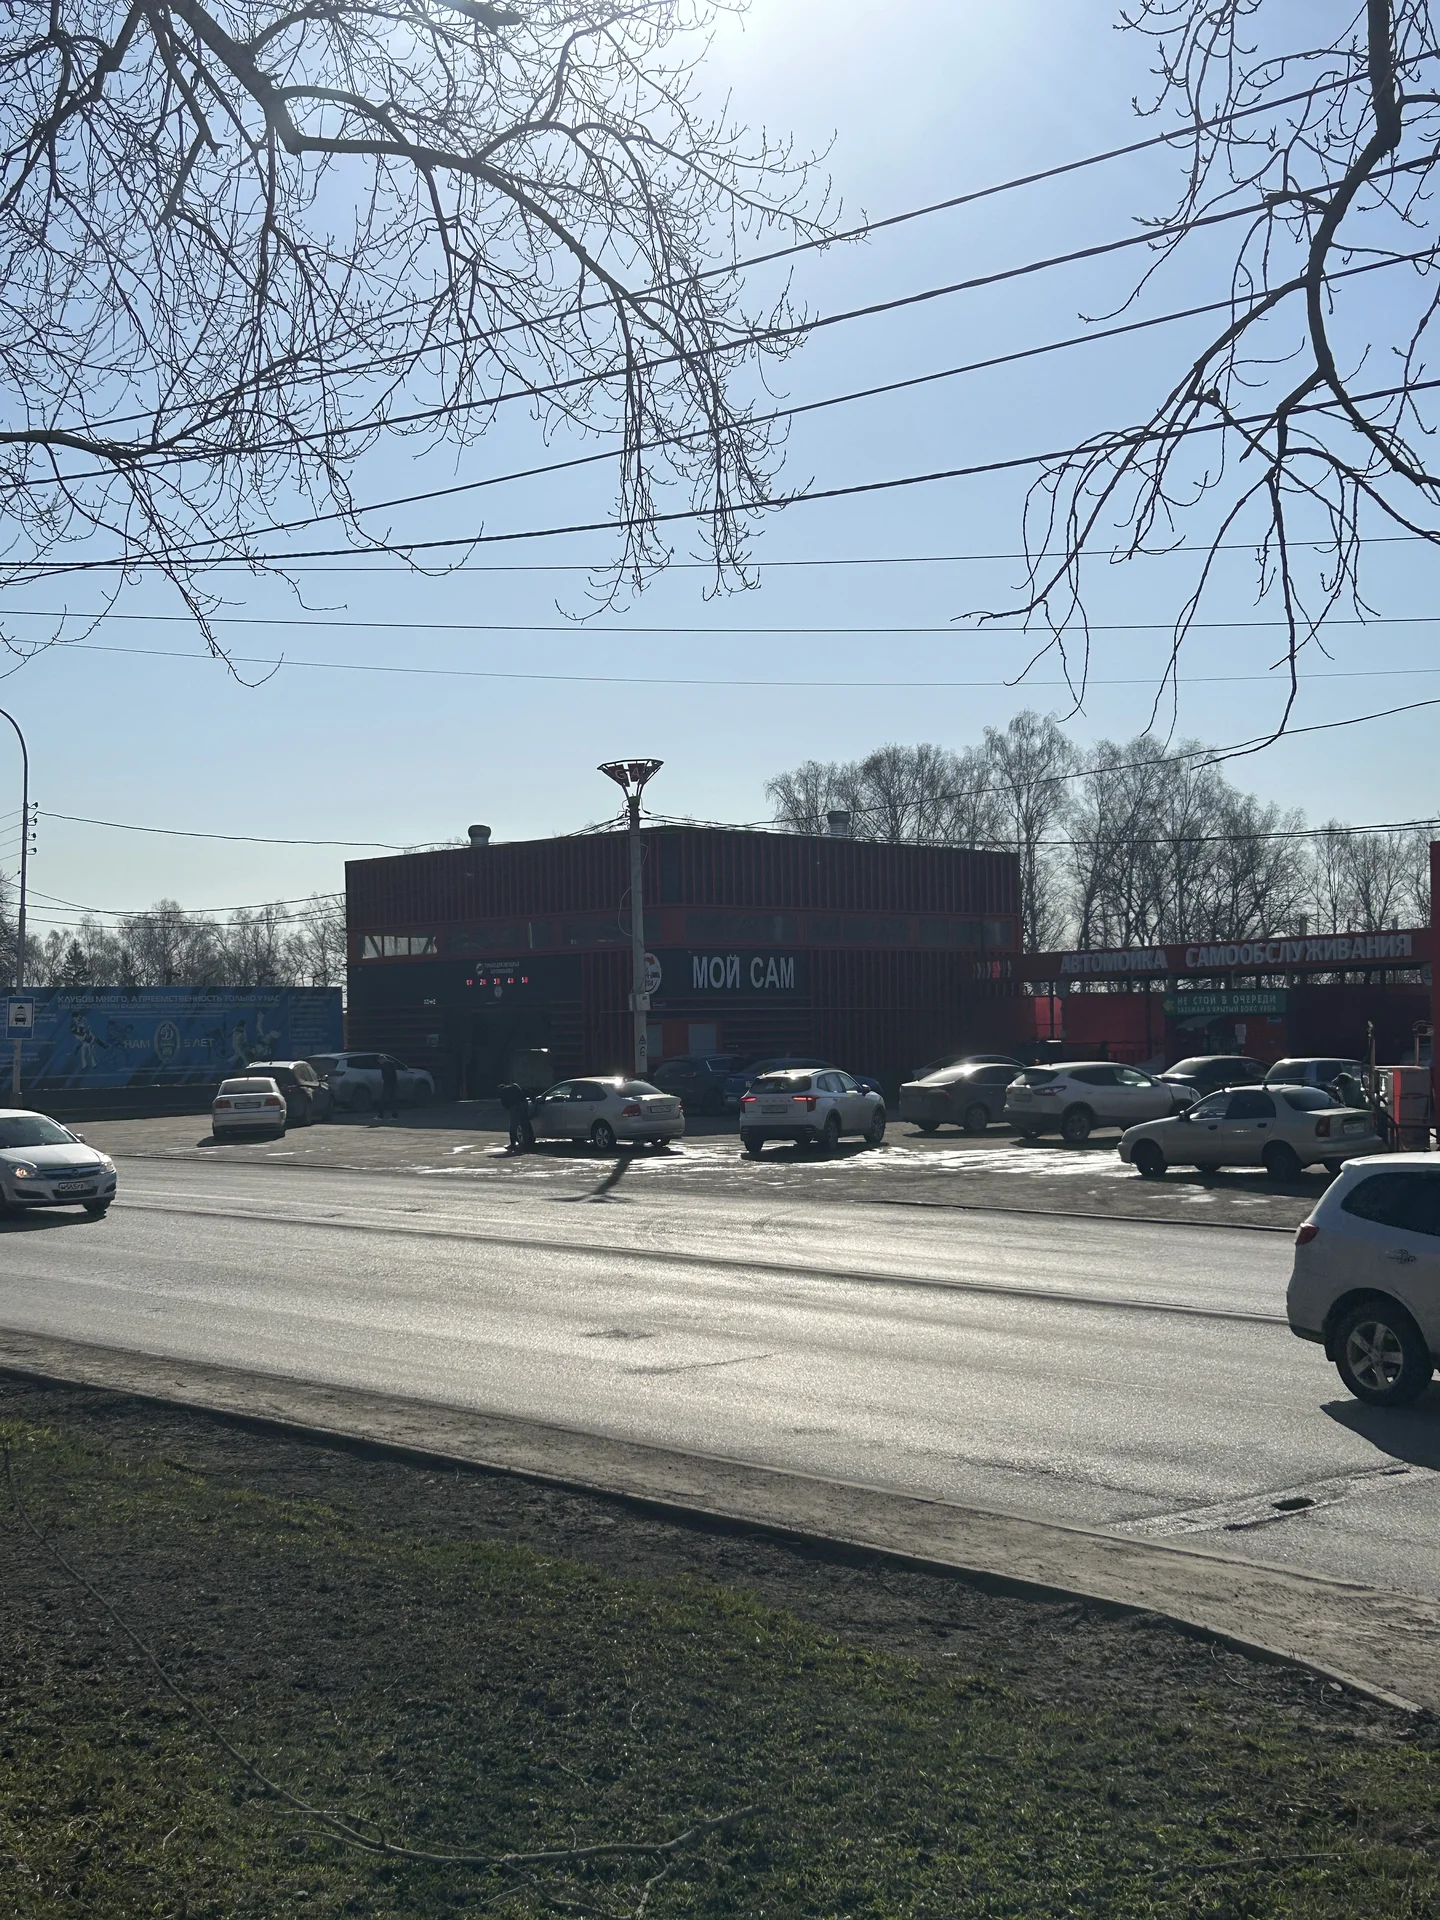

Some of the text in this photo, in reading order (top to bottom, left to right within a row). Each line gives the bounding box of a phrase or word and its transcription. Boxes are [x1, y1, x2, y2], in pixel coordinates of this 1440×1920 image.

[1060, 934, 1412, 974] АВТОМОЙКА САМООБСЛУЖИВАНИЯ
[693, 954, 794, 989] МОЙ САМ
[58, 995, 94, 1003] КЛУБОВ
[95, 995, 130, 1004] МНОГО,
[131, 995, 138, 1003] А
[138, 995, 222, 1003] ПРЕЕМСТВЕННОСТЬ
[1177, 994, 1276, 1005] НЕ СТОЙ В ОЧЕРЕДИ
[124, 1039, 150, 1049] НАМ
[193, 1038, 214, 1048] ЛЕТ
